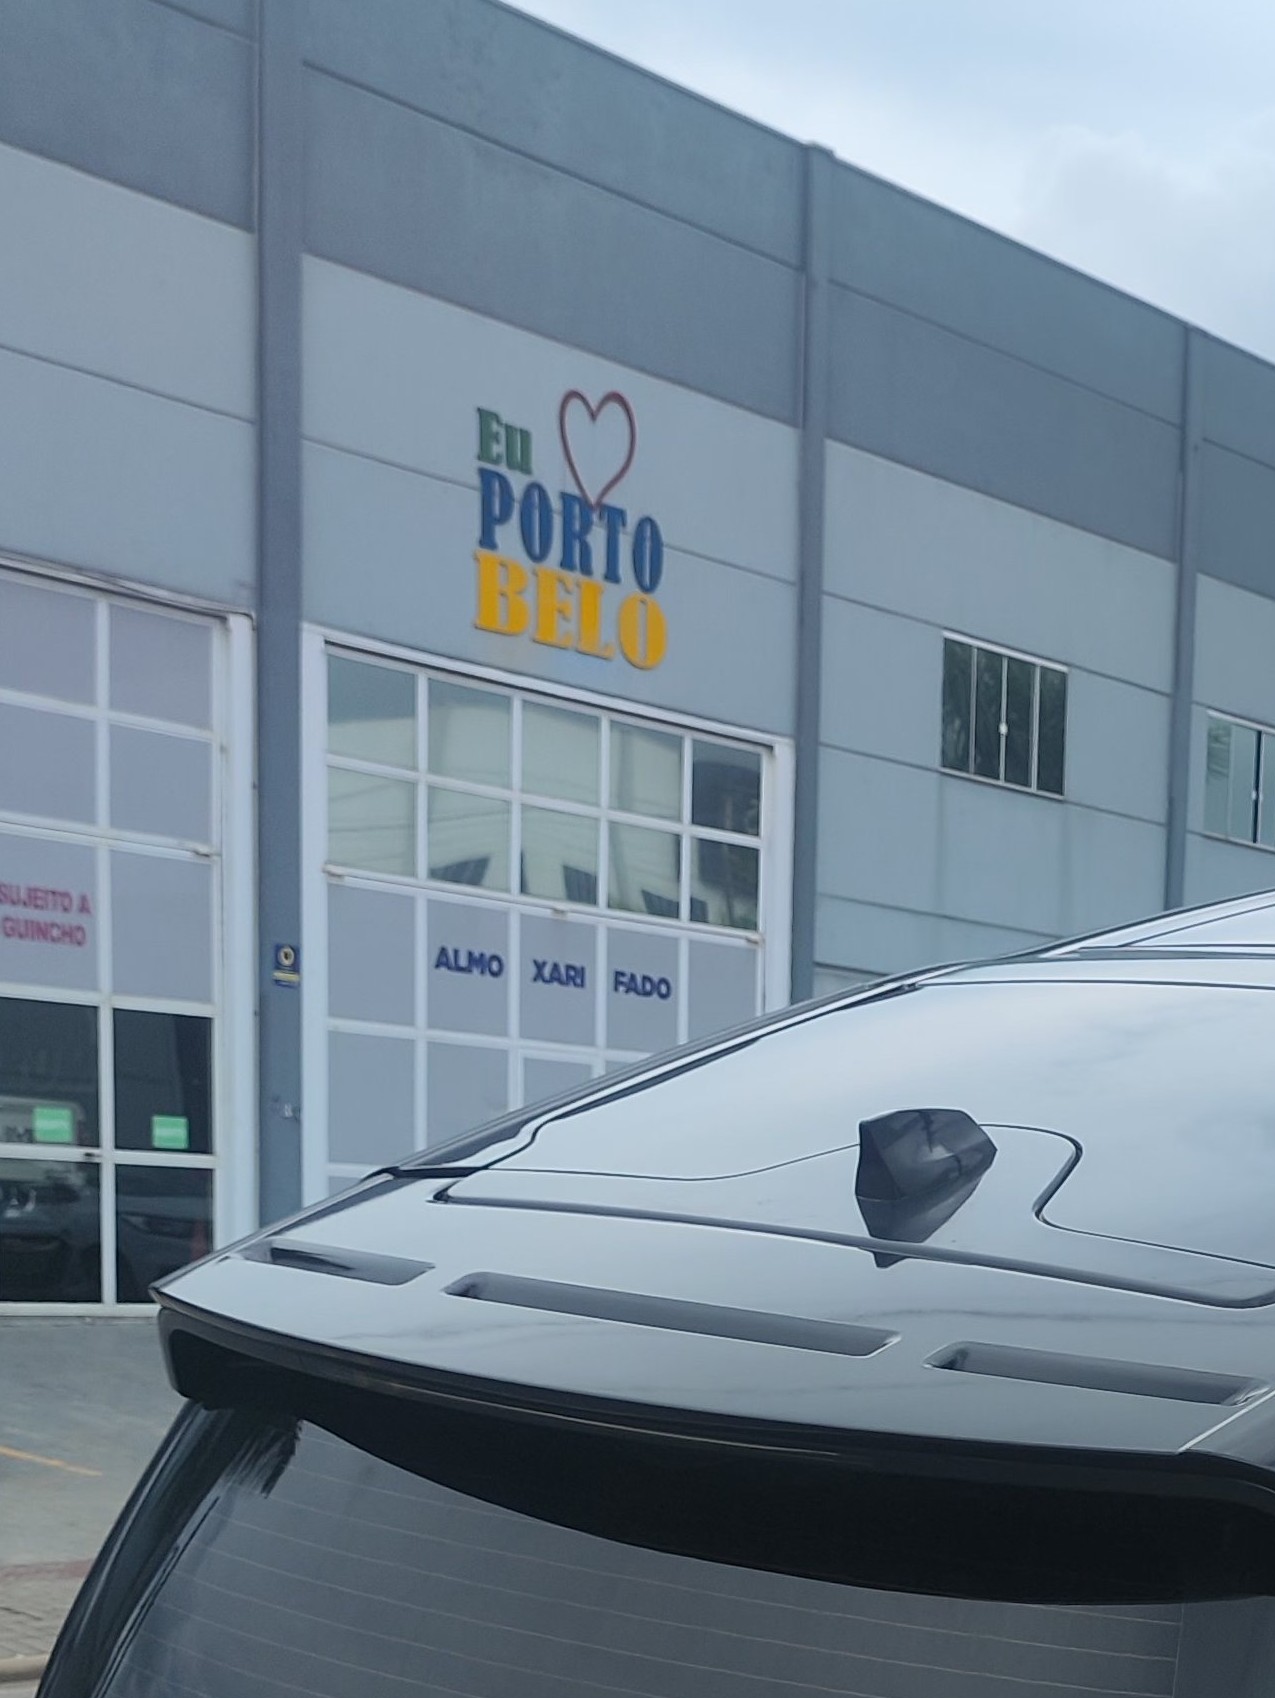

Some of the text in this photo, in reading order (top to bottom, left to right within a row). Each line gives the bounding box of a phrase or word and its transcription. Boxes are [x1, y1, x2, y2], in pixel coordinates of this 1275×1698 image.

[477, 407, 532, 475] Eu
[478, 466, 663, 594] PORTO
[474, 550, 668, 671] BELO
[3, 916, 87, 948] GUINCHO
[78, 893, 92, 915] A
[435, 946, 672, 1000] ALMO XARI FADO
